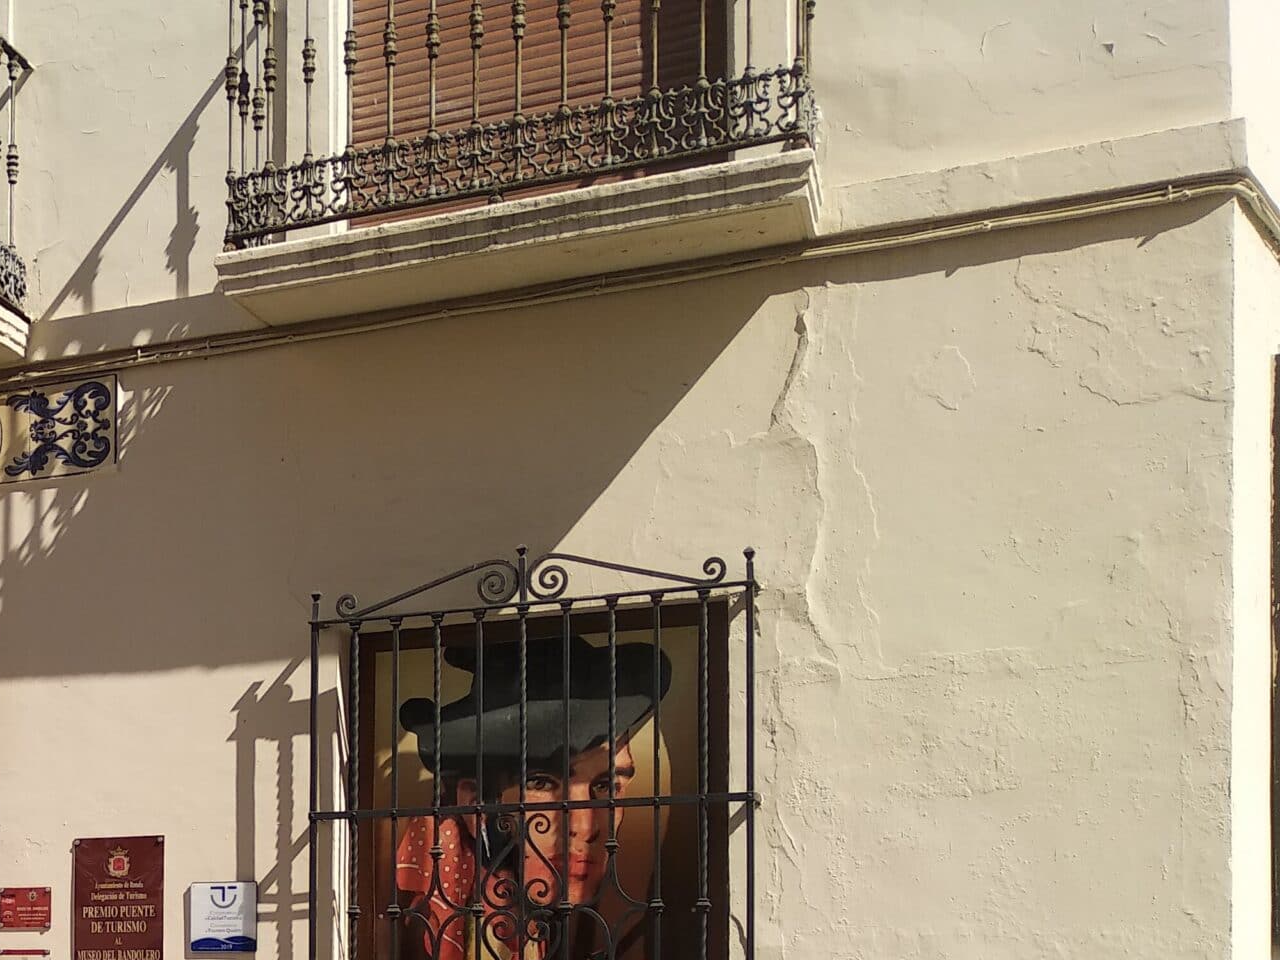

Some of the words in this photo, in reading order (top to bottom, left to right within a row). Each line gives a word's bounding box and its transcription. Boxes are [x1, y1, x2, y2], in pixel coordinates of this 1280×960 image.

[126, 892, 147, 900] Turismo
[83, 906, 118, 918] PREMIO
[120, 905, 156, 918] PUENTE
[91, 921, 103, 933] DE
[105, 920, 147, 933] TURISMO
[114, 937, 122, 945] AL
[77, 950, 102, 960] MUSEO
[102, 950, 116, 960] DEL
[118, 949, 160, 960] BANDOLERO
